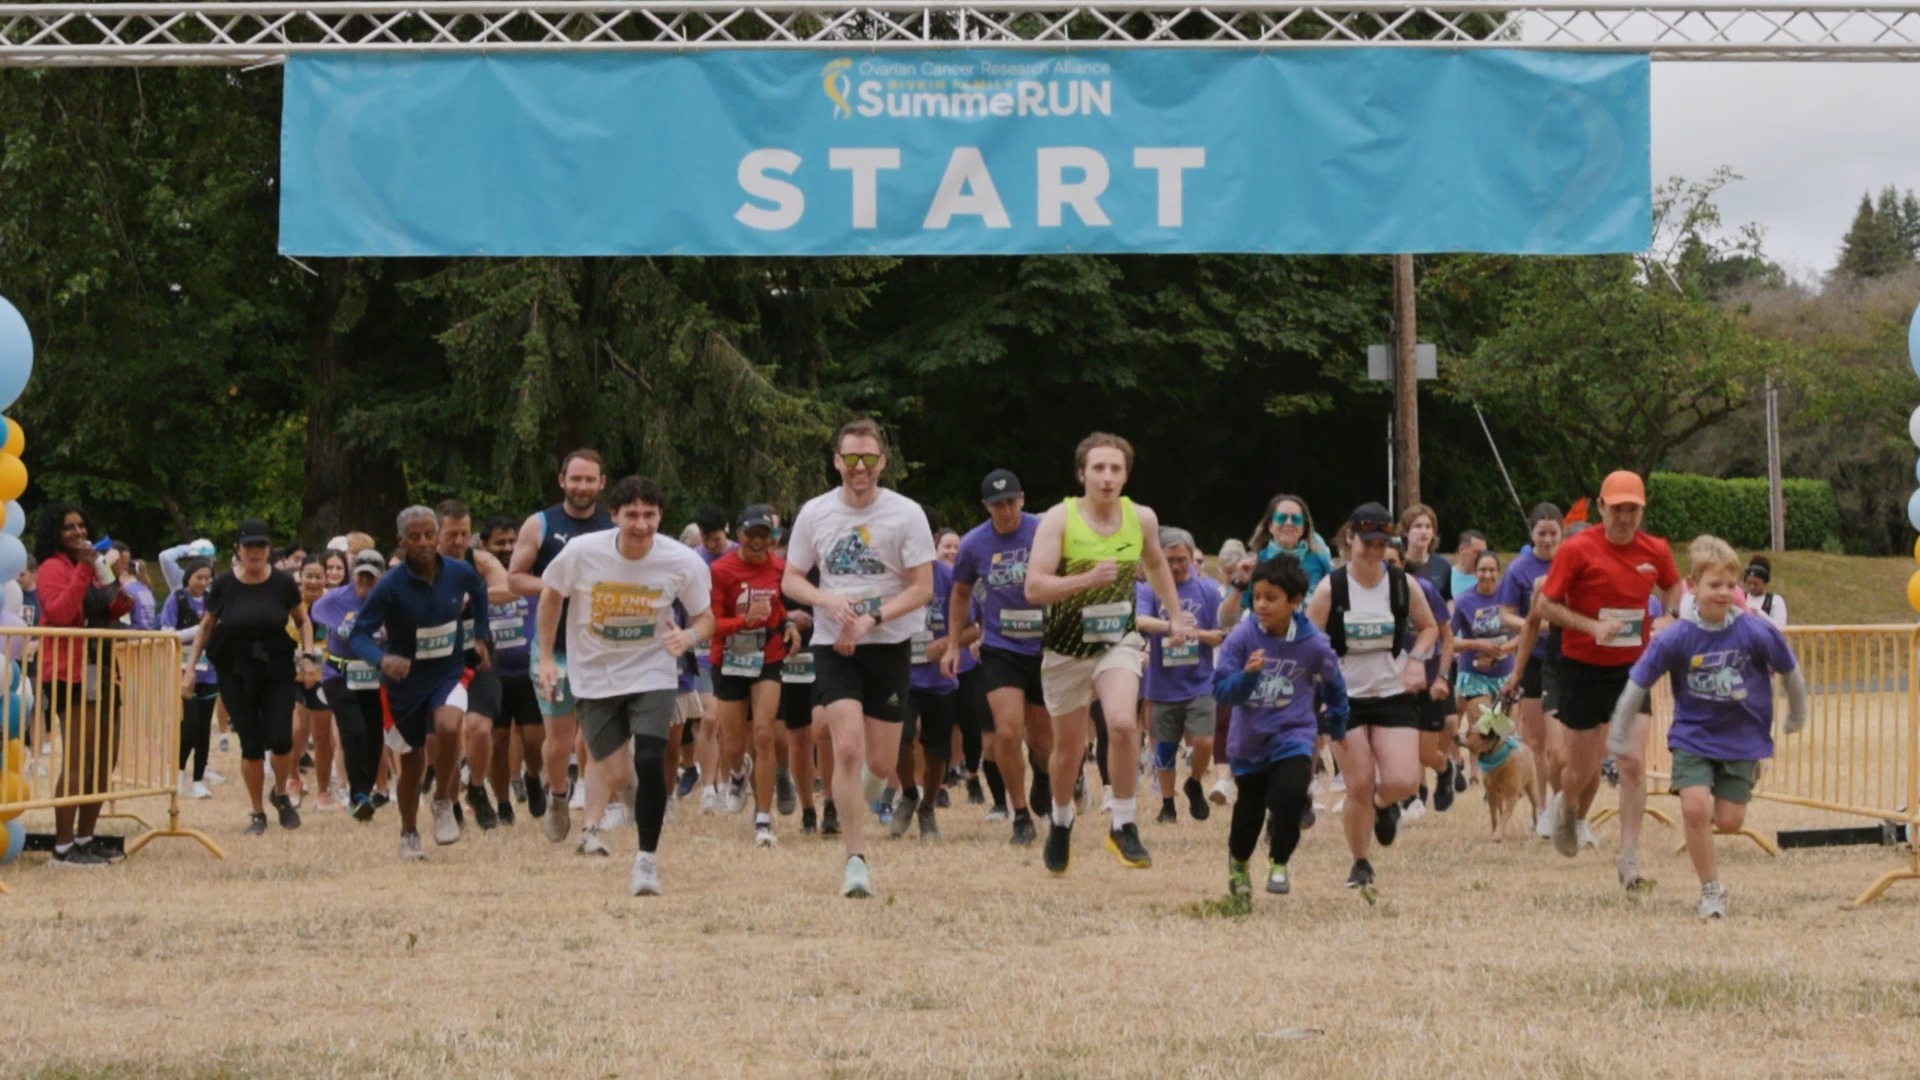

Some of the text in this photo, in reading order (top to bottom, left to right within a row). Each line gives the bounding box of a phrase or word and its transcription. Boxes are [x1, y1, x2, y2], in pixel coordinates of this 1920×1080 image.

[858, 60, 1111, 76] Ovarian Cancer Research Alliance
[857, 80, 1112, 118] SummeRUN
[734, 146, 1206, 231] START
[1096, 618, 1120, 630] 270
[1358, 624, 1382, 636] 294
[616, 628, 641, 638] 309
